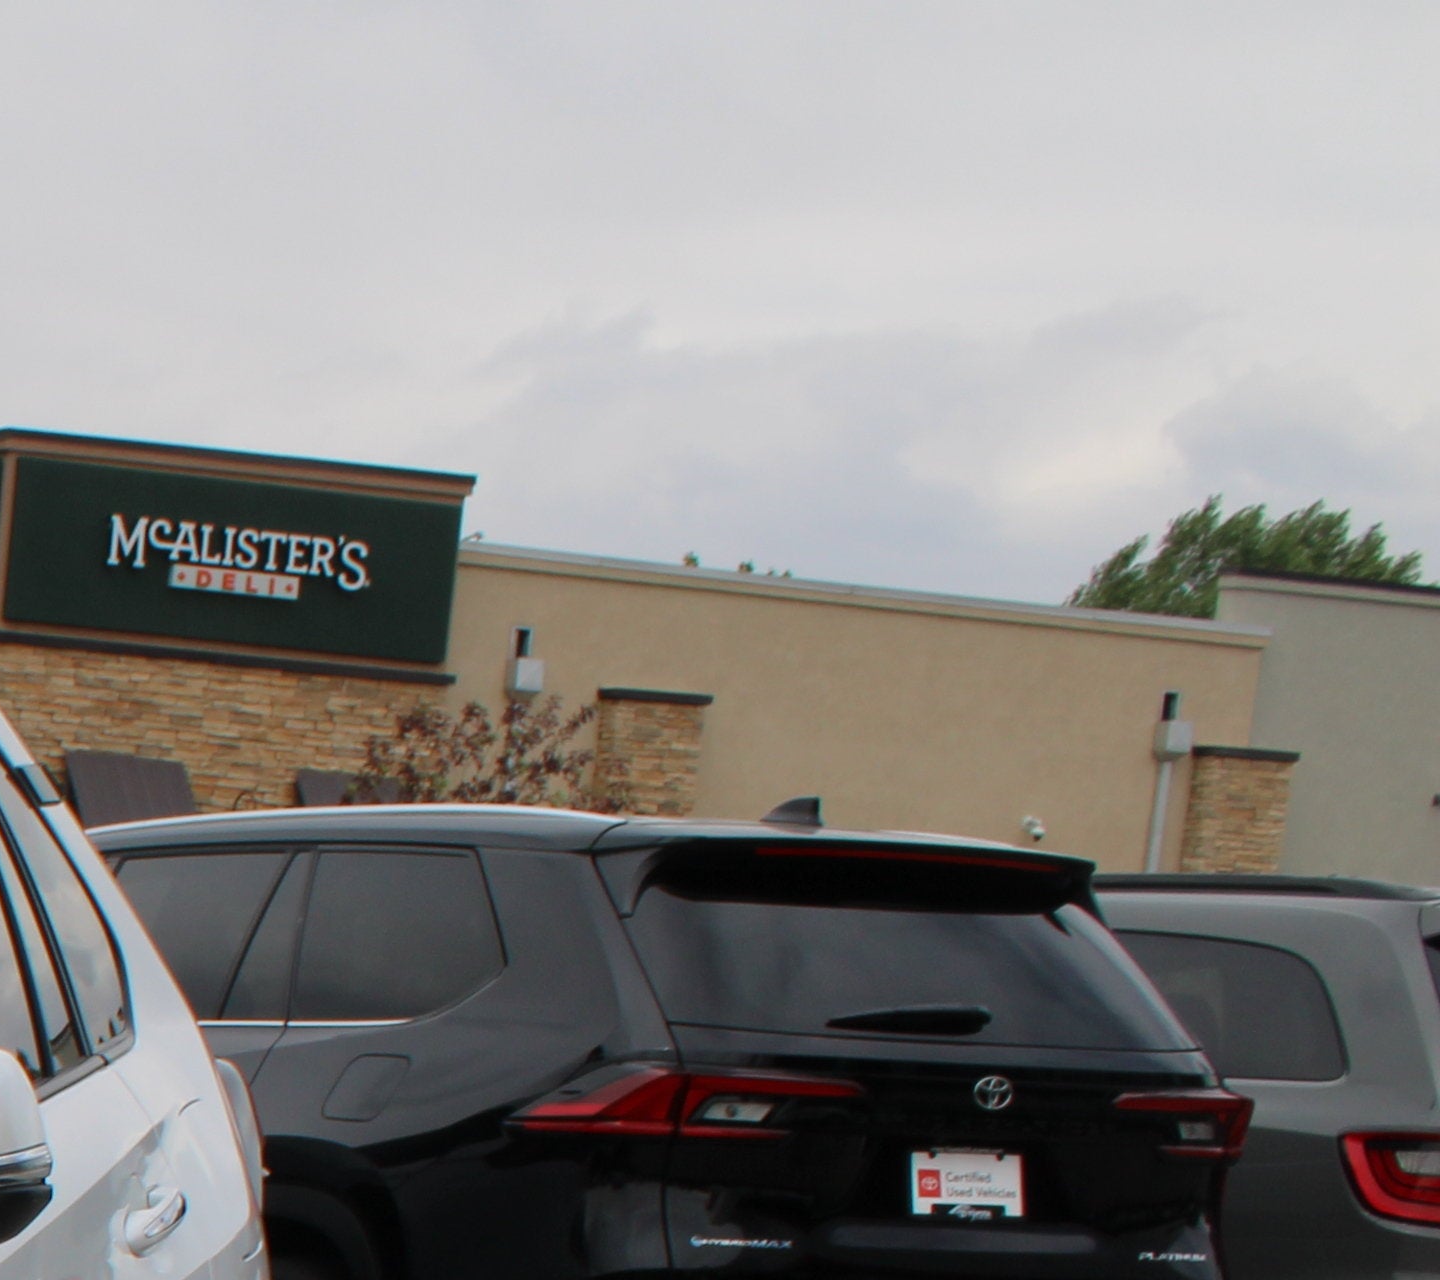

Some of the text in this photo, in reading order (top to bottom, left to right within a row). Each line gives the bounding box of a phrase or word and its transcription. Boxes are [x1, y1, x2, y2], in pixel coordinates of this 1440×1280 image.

[195, 570, 277, 596] DELI
[945, 1171, 992, 1183] Certified
[946, 1187, 1017, 1198] Used Vehicles
